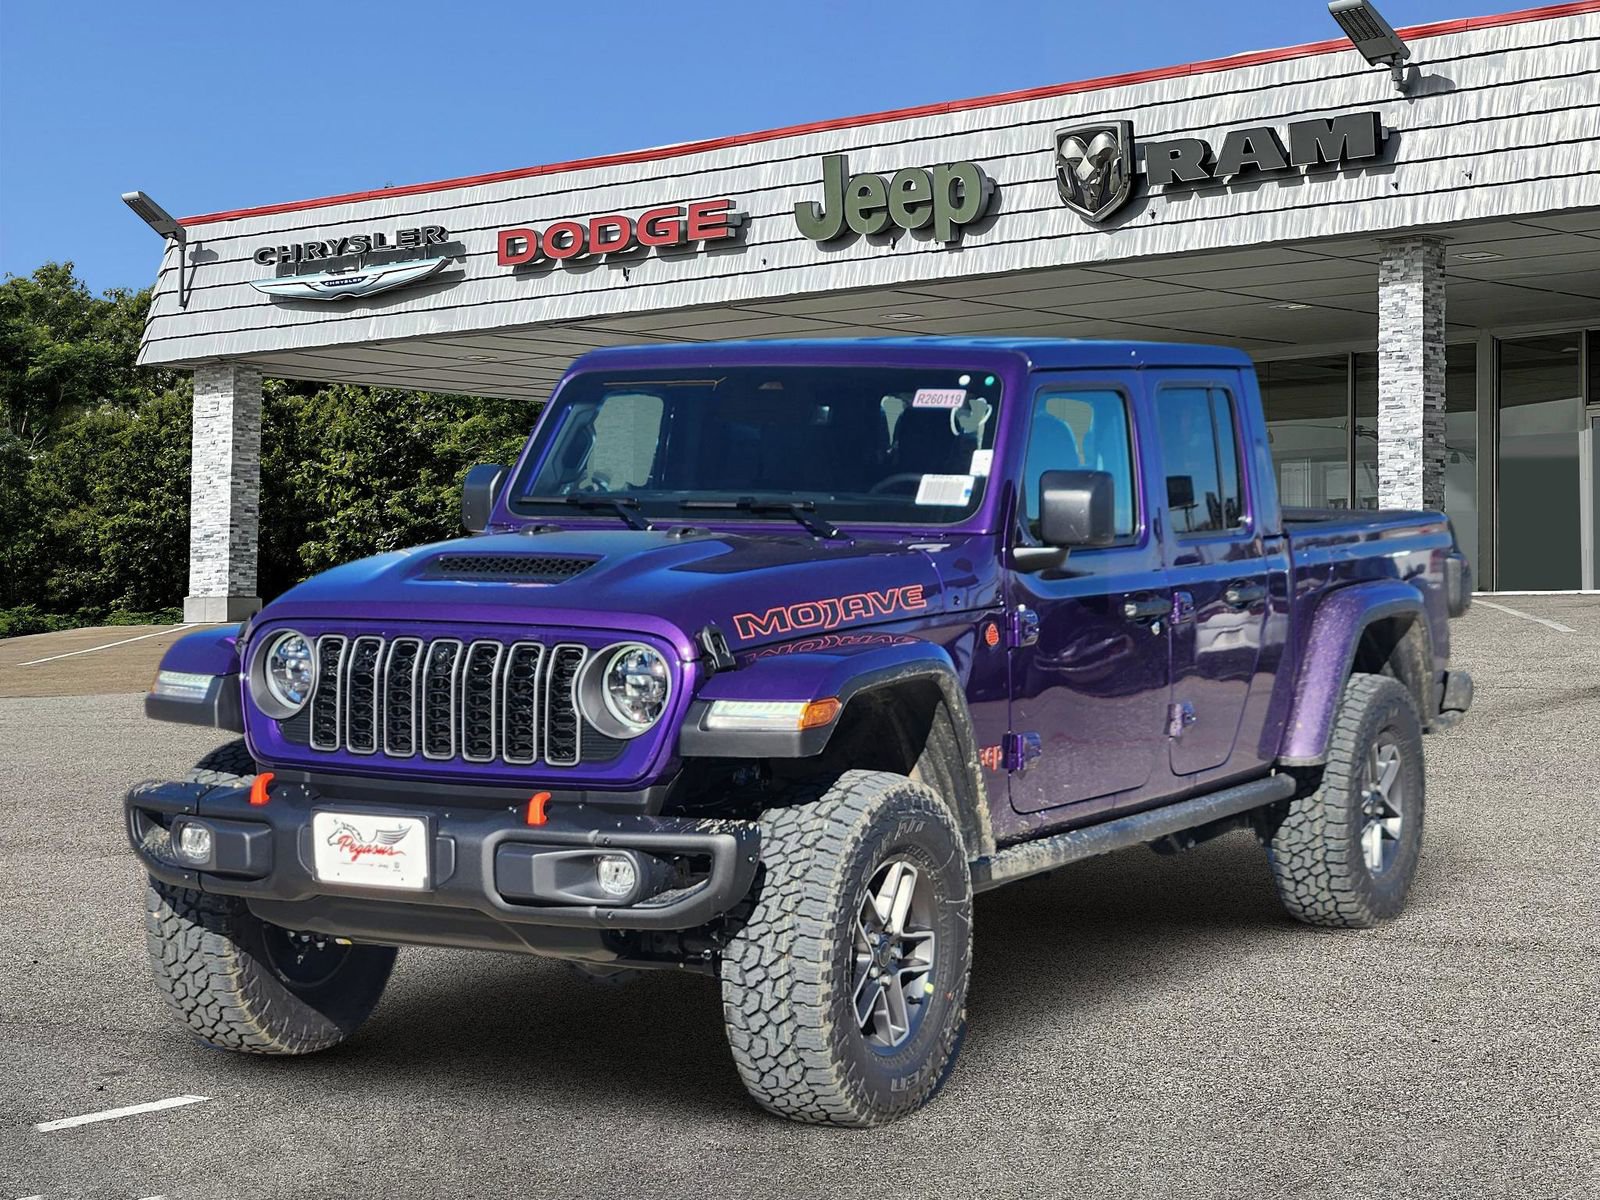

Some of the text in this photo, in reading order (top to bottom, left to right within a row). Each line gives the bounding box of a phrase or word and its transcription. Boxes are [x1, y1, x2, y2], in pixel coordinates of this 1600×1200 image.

[1147, 111, 1382, 187] RAM
[795, 155, 988, 243] Jeep
[253, 225, 449, 266] CHRYSLER
[498, 199, 733, 267] DODGE
[916, 392, 962, 405] R260119
[733, 584, 927, 640] MOJAVE
[979, 745, 1003, 771] eep
[338, 835, 407, 862] Pegasus
